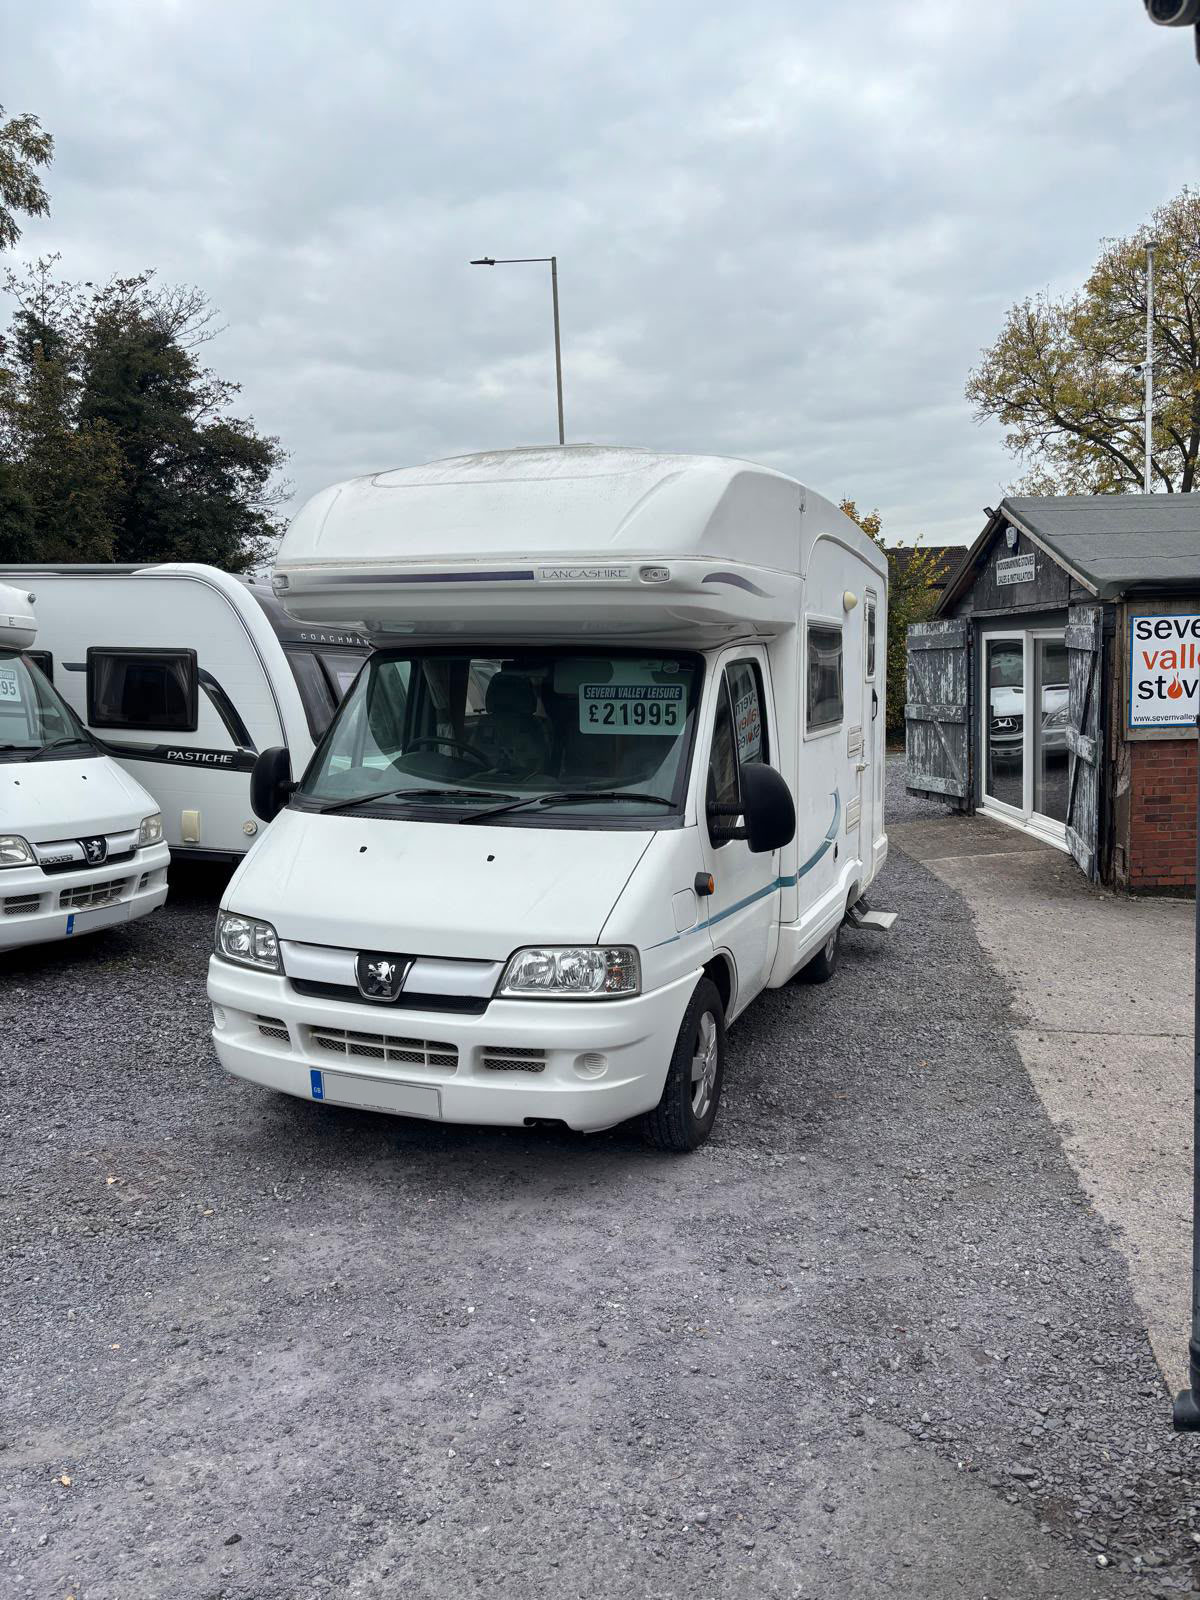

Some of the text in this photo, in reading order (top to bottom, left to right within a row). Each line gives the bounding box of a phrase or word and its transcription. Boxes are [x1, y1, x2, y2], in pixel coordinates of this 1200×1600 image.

[542, 569, 629, 579] LANCASHIRE
[300, 633, 369, 646] COACHMAN
[1142, 643, 1200, 670] vall
[585, 687, 680, 699] SEVERN VALLEY LEISURE
[589, 702, 677, 726] £21995
[166, 750, 233, 764] PASTICHE
